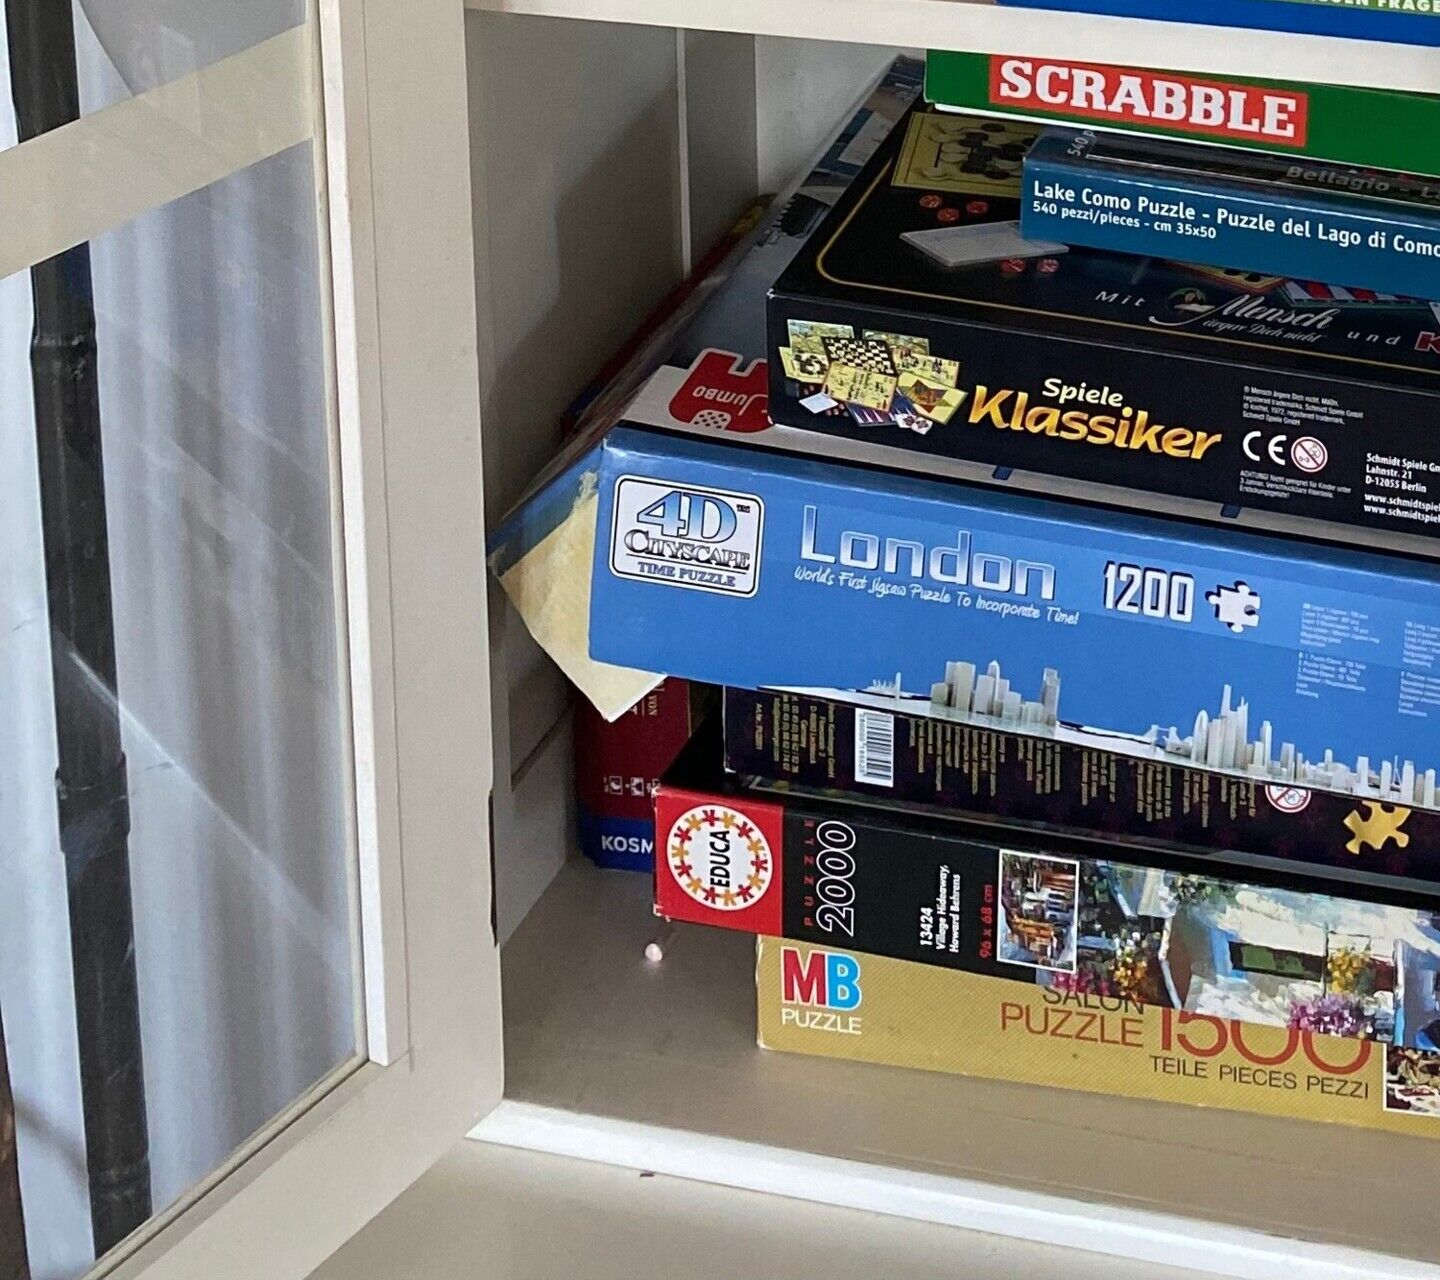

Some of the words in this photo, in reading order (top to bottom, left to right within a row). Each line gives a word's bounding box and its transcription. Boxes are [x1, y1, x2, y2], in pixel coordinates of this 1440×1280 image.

[999, 58, 1297, 139] SCRABBLE
[1285, 164, 1391, 196] Bellagio
[1032, 200, 1057, 216] 540
[1061, 205, 1140, 229] pezzi/pieces
[1154, 220, 1172, 233] cm
[1176, 224, 1217, 240] 35x50
[1034, 180, 1076, 202] Lake
[1082, 188, 1131, 211] Como
[1137, 195, 1196, 221] Puzzle
[1216, 208, 1276, 234] Puzzle
[1281, 216, 1312, 238] del
[1317, 222, 1362, 247] Lago
[1367, 230, 1387, 250] di
[1041, 378, 1124, 409] Spiele
[966, 384, 1223, 461] Klassiker
[1366, 453, 1401, 468] Schmidt
[1402, 457, 1428, 471] Spiele
[636, 489, 738, 543] 4D
[637, 560, 677, 579] TIME
[678, 568, 737, 588] PUZZLE
[802, 504, 1057, 600] London
[838, 572, 868, 590] First
[870, 576, 908, 599] Jigsaw
[910, 583, 952, 603] Puzzle
[956, 590, 971, 606] To
[975, 595, 1042, 620] Incorporate
[1044, 605, 1080, 626] Time!
[1101, 559, 1196, 623] 1200
[710, 829, 731, 888] EDUCA
[815, 820, 857, 938] 2000
[919, 906, 934, 947] 13424
[936, 913, 947, 950] Village
[949, 912, 960, 953] Howard
[780, 946, 862, 1011] MB
[780, 1007, 863, 1035] PUZZLE
[1000, 1001, 1144, 1048] PUZZLE
[1148, 1054, 1209, 1079] TEILE
[1218, 1064, 1298, 1091] PIECES
[1306, 1075, 1370, 1101] PEZZI
